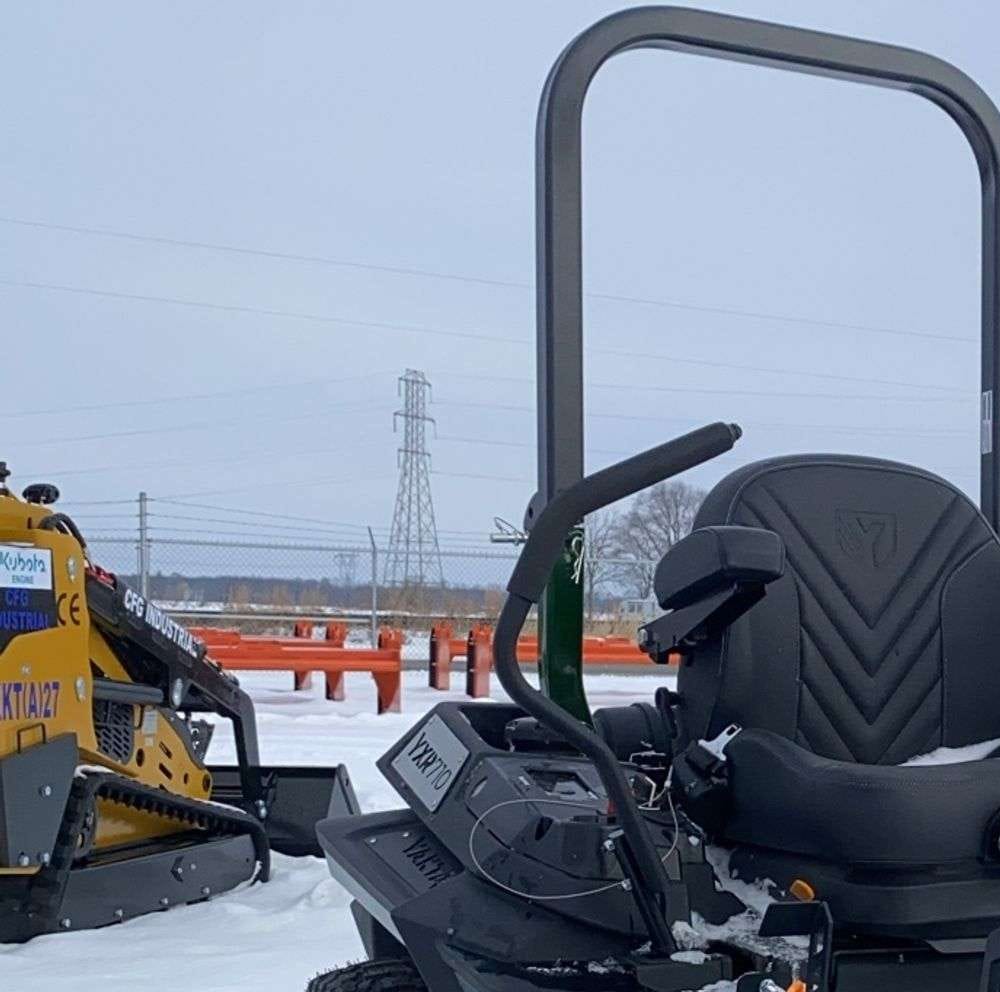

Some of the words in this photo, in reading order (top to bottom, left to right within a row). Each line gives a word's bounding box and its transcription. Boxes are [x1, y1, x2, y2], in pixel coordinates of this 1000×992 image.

[0, 552, 45, 573] Kubota
[124, 589, 144, 617] CFG
[0, 681, 59, 720] KT(A)27
